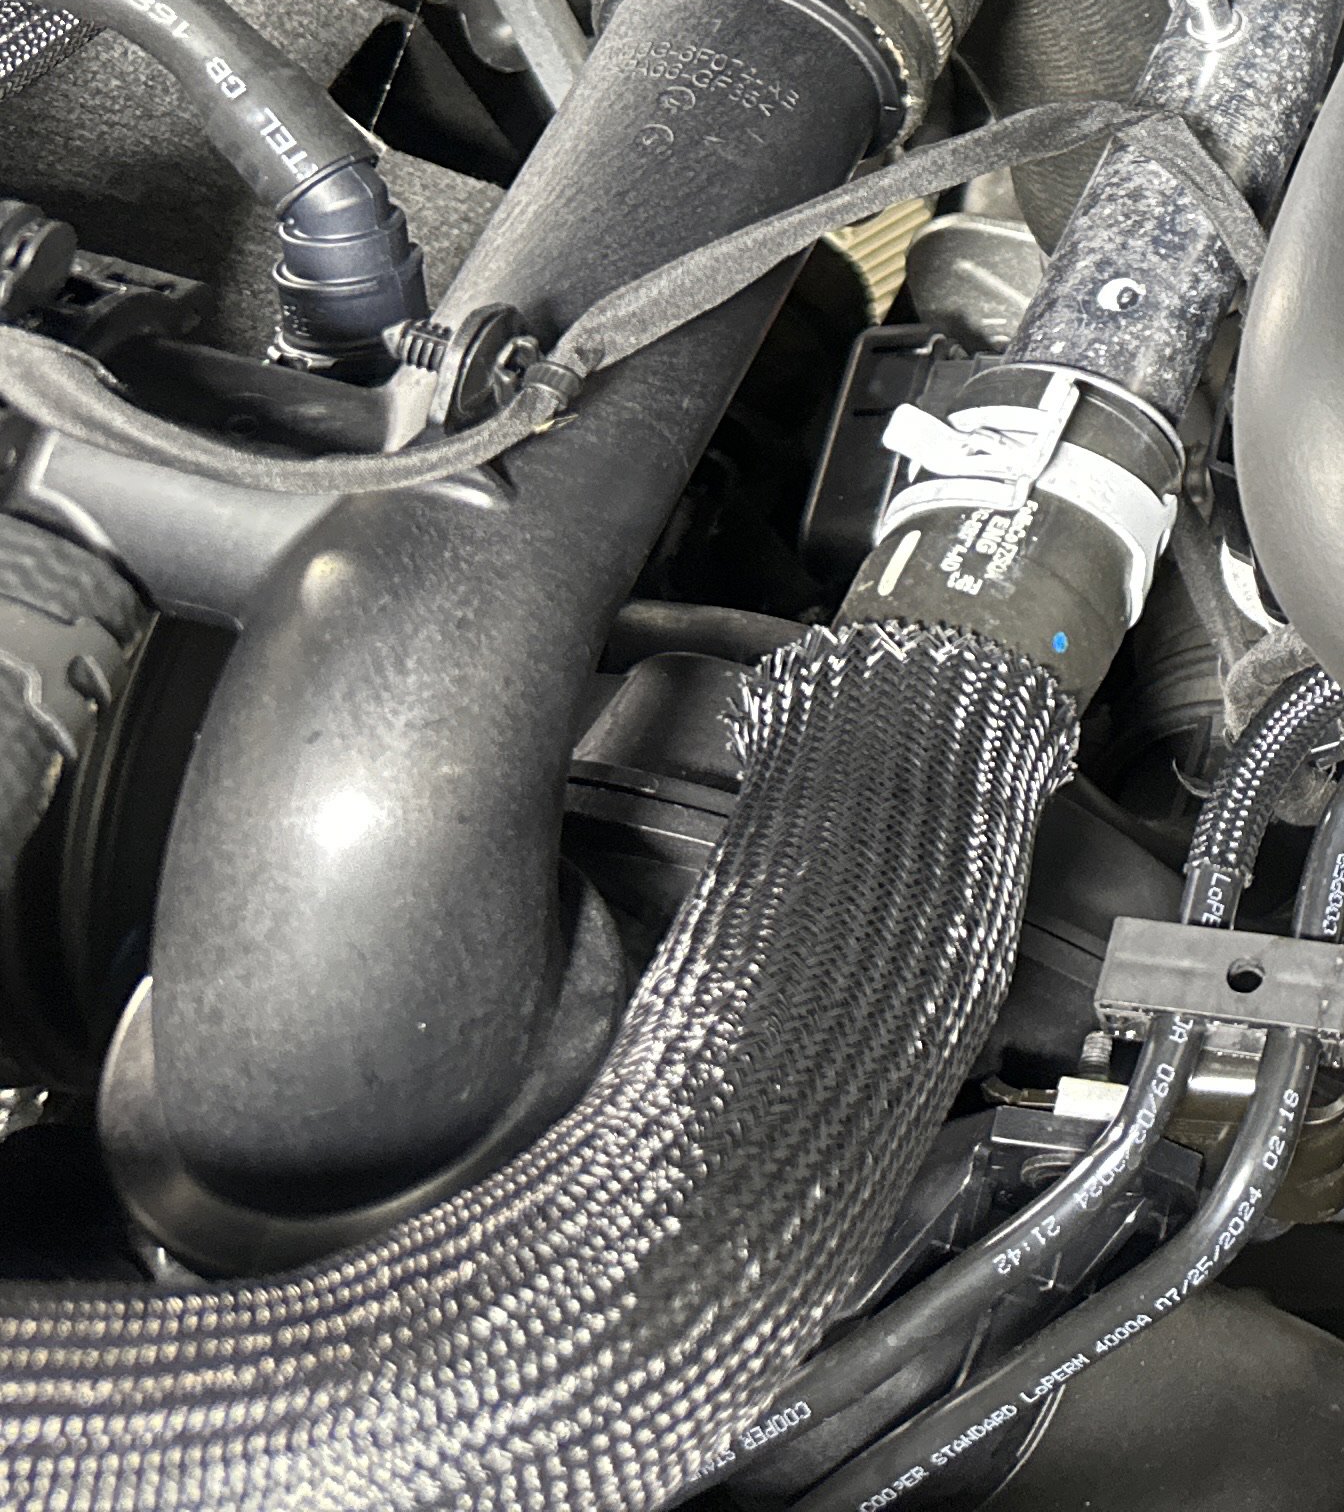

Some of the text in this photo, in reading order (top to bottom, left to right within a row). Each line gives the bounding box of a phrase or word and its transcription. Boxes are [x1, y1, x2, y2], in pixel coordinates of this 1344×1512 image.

[205, 56, 247, 100] GB
[975, 514, 1012, 555] ENG
[1201, 871, 1232, 928] LoPE
[1262, 1088, 1300, 1172] 02:18
[992, 1215, 1061, 1275] 21:42
[930, 1403, 1019, 1468] STANDARD
[1019, 1351, 1092, 1405] LoPERM
[1093, 1312, 1153, 1356] 4000A
[740, 1399, 813, 1452] COOPER
